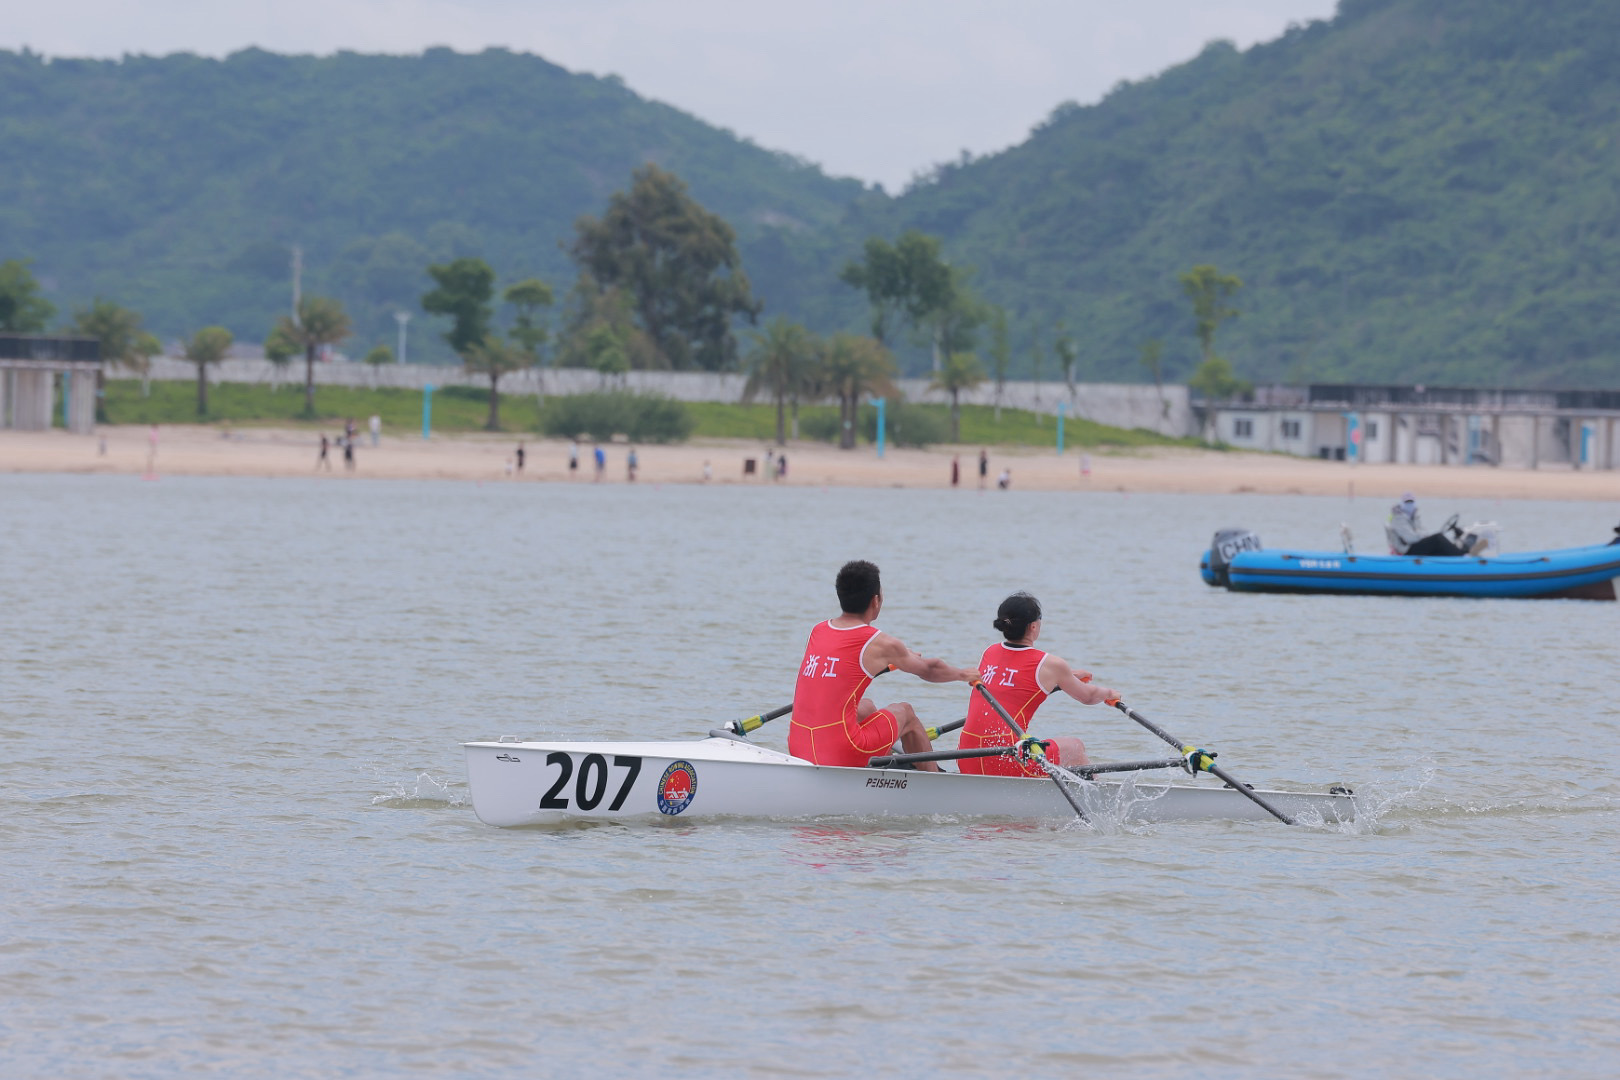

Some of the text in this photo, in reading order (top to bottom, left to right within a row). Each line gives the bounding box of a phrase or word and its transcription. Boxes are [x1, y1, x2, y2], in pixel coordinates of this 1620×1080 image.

[1221, 534, 1260, 560] CHN
[803, 654, 839, 678] 浙江
[982, 664, 1018, 686] 浙江
[539, 751, 642, 811] 207
[865, 778, 908, 790] PEISHENG
